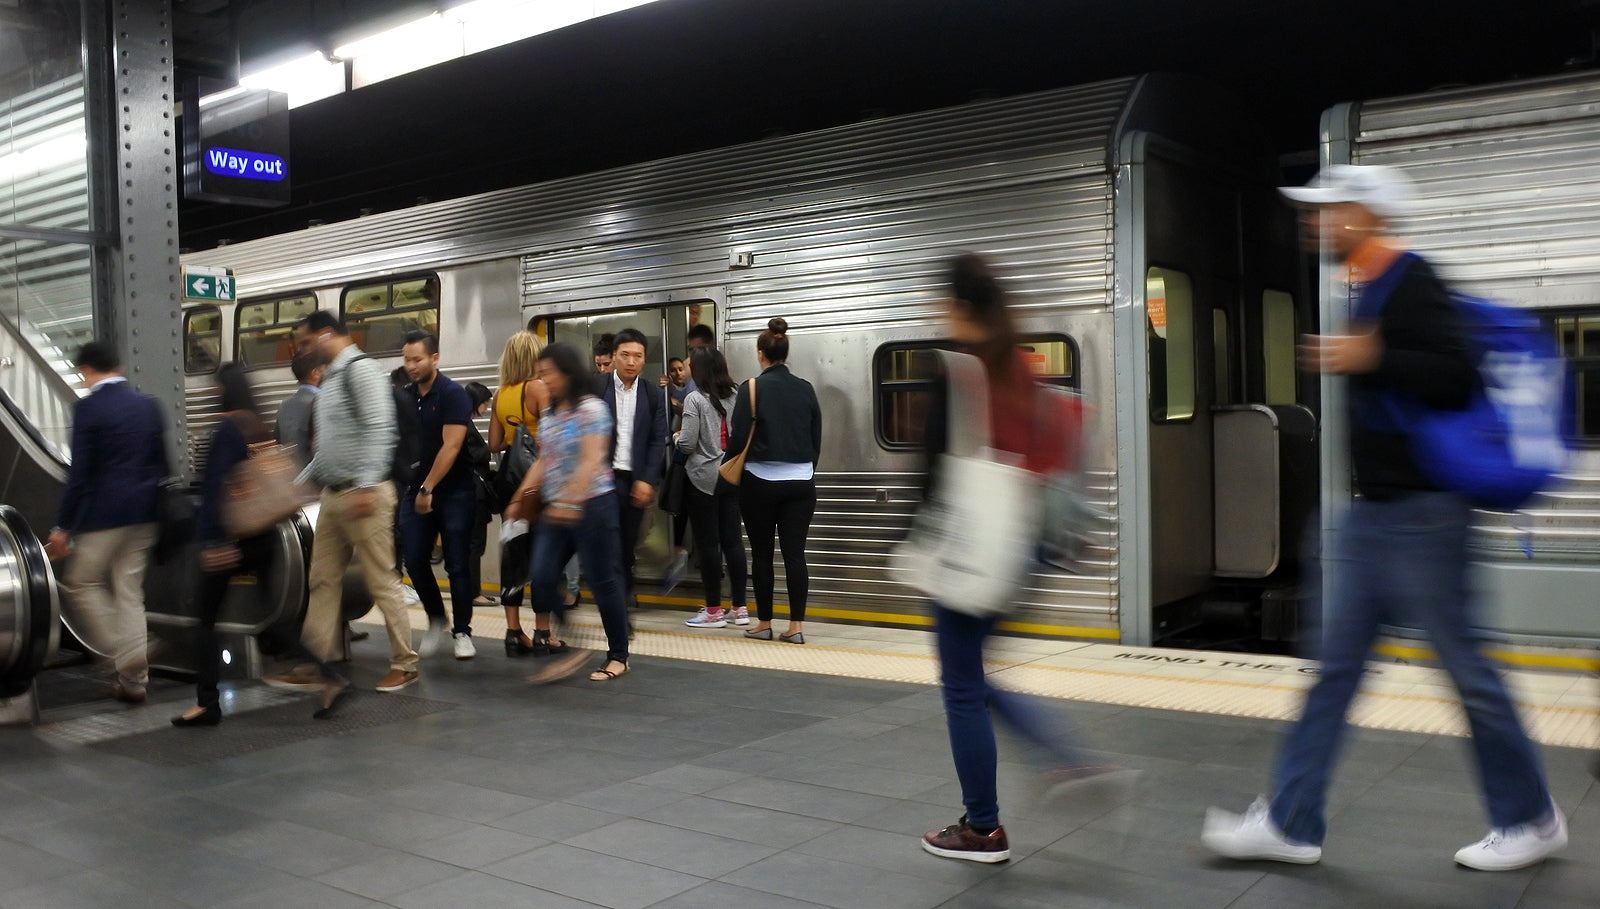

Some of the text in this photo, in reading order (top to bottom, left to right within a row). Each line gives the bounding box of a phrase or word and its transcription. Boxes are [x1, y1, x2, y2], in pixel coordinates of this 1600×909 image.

[209, 150, 282, 175] Way out
[1113, 653, 1206, 664] MIND
[1218, 661, 1291, 671] THE
